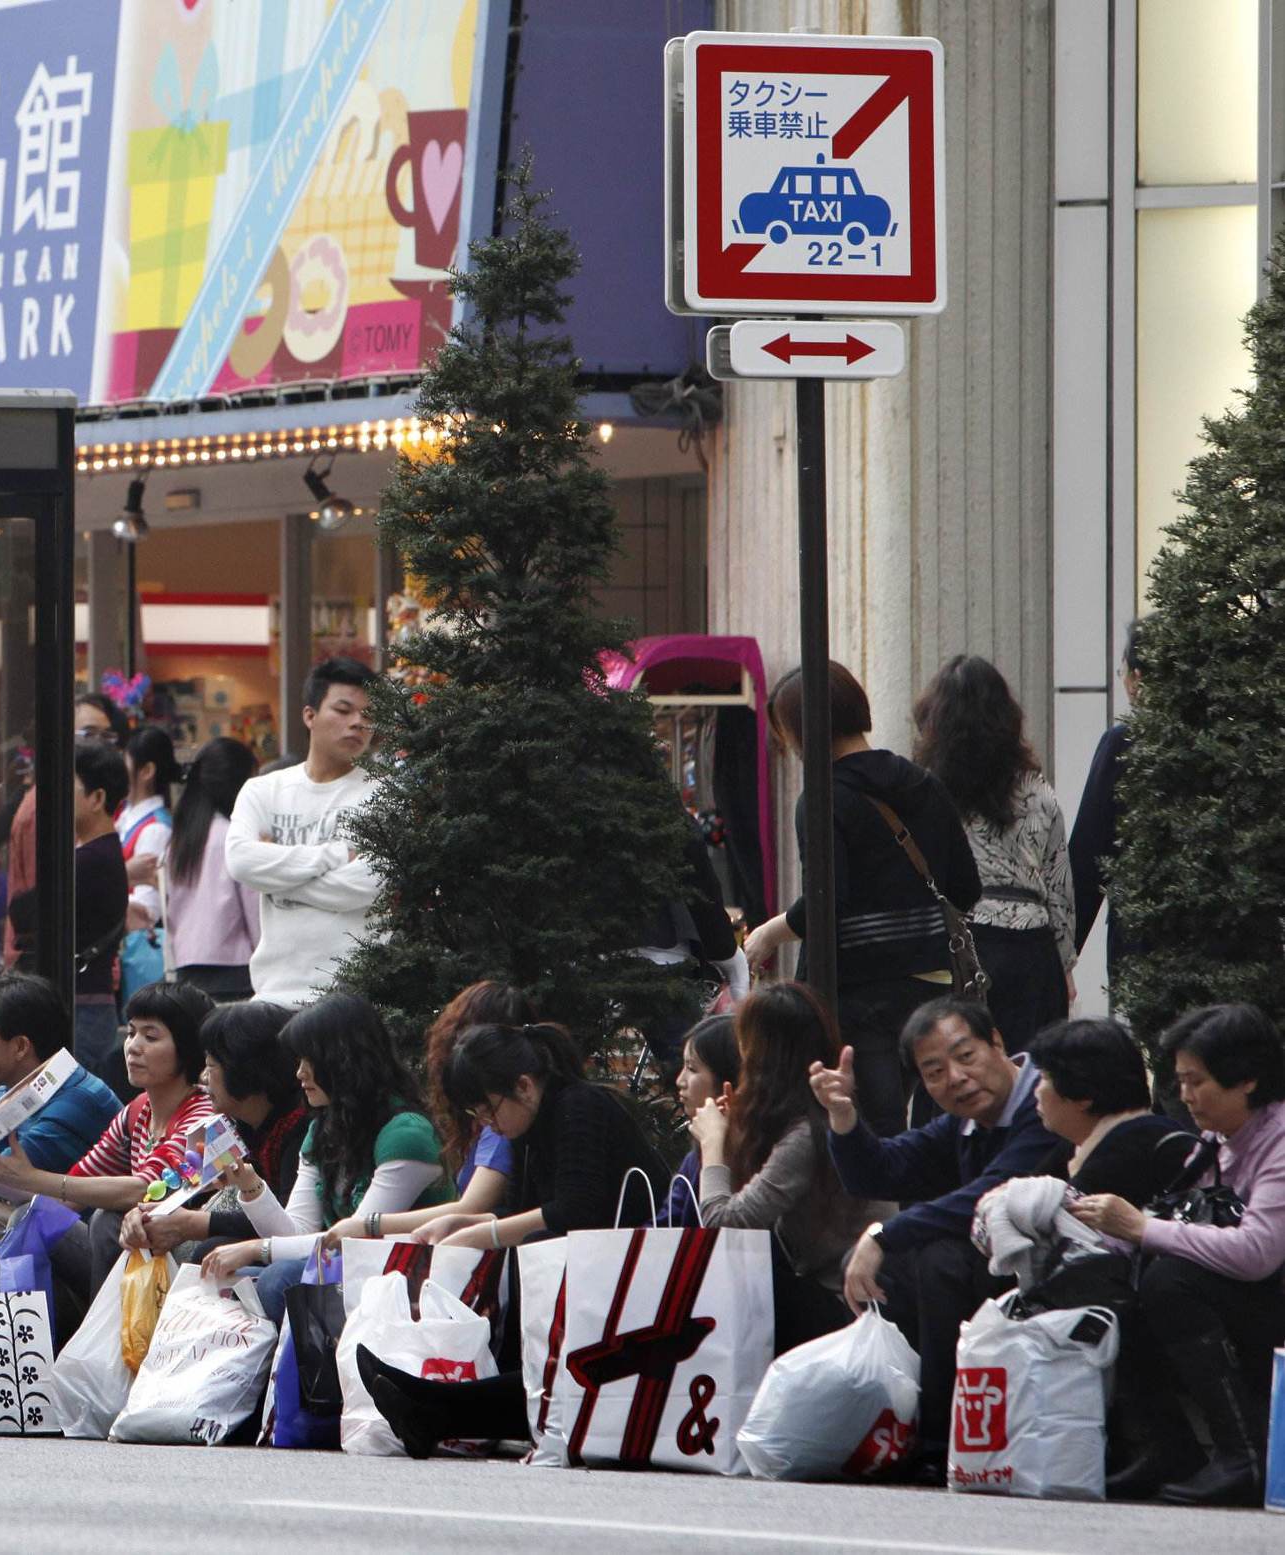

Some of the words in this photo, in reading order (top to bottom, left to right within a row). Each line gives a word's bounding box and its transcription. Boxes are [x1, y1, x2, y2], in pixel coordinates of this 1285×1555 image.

[728, 80, 828, 107] タクシー
[728, 110, 830, 140] 乗車禁止
[788, 200, 843, 223] TAXI
[807, 242, 883, 267] 22-1
[272, 814, 302, 828] THE
